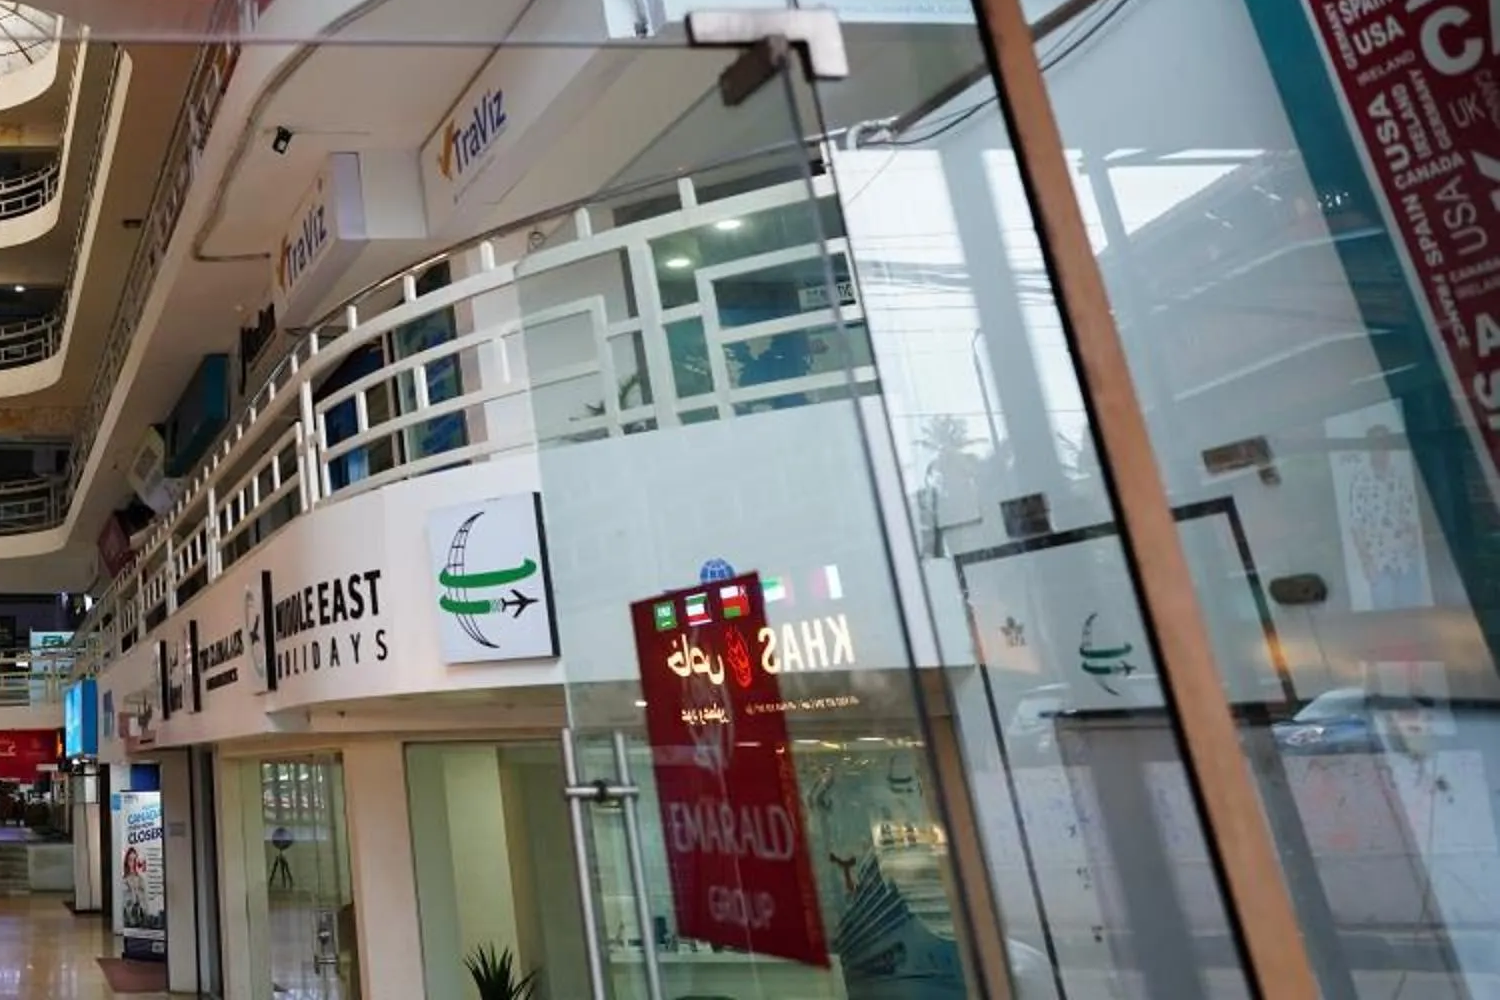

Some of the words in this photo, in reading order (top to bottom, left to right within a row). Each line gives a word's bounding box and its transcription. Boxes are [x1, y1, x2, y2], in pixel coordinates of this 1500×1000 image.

[1351, 13, 1406, 57] USA
[451, 88, 507, 175] TraViz
[1367, 90, 1412, 173] USA
[1447, 92, 1487, 129] UK
[1393, 151, 1466, 191] CANADA
[1401, 193, 1445, 267] SPAIN
[1433, 174, 1489, 256] USA
[316, 570, 382, 627] EAST
[277, 630, 389, 680] HOLIDAYS
[669, 801, 795, 861] EMARALD
[707, 884, 775, 930] GROUP
